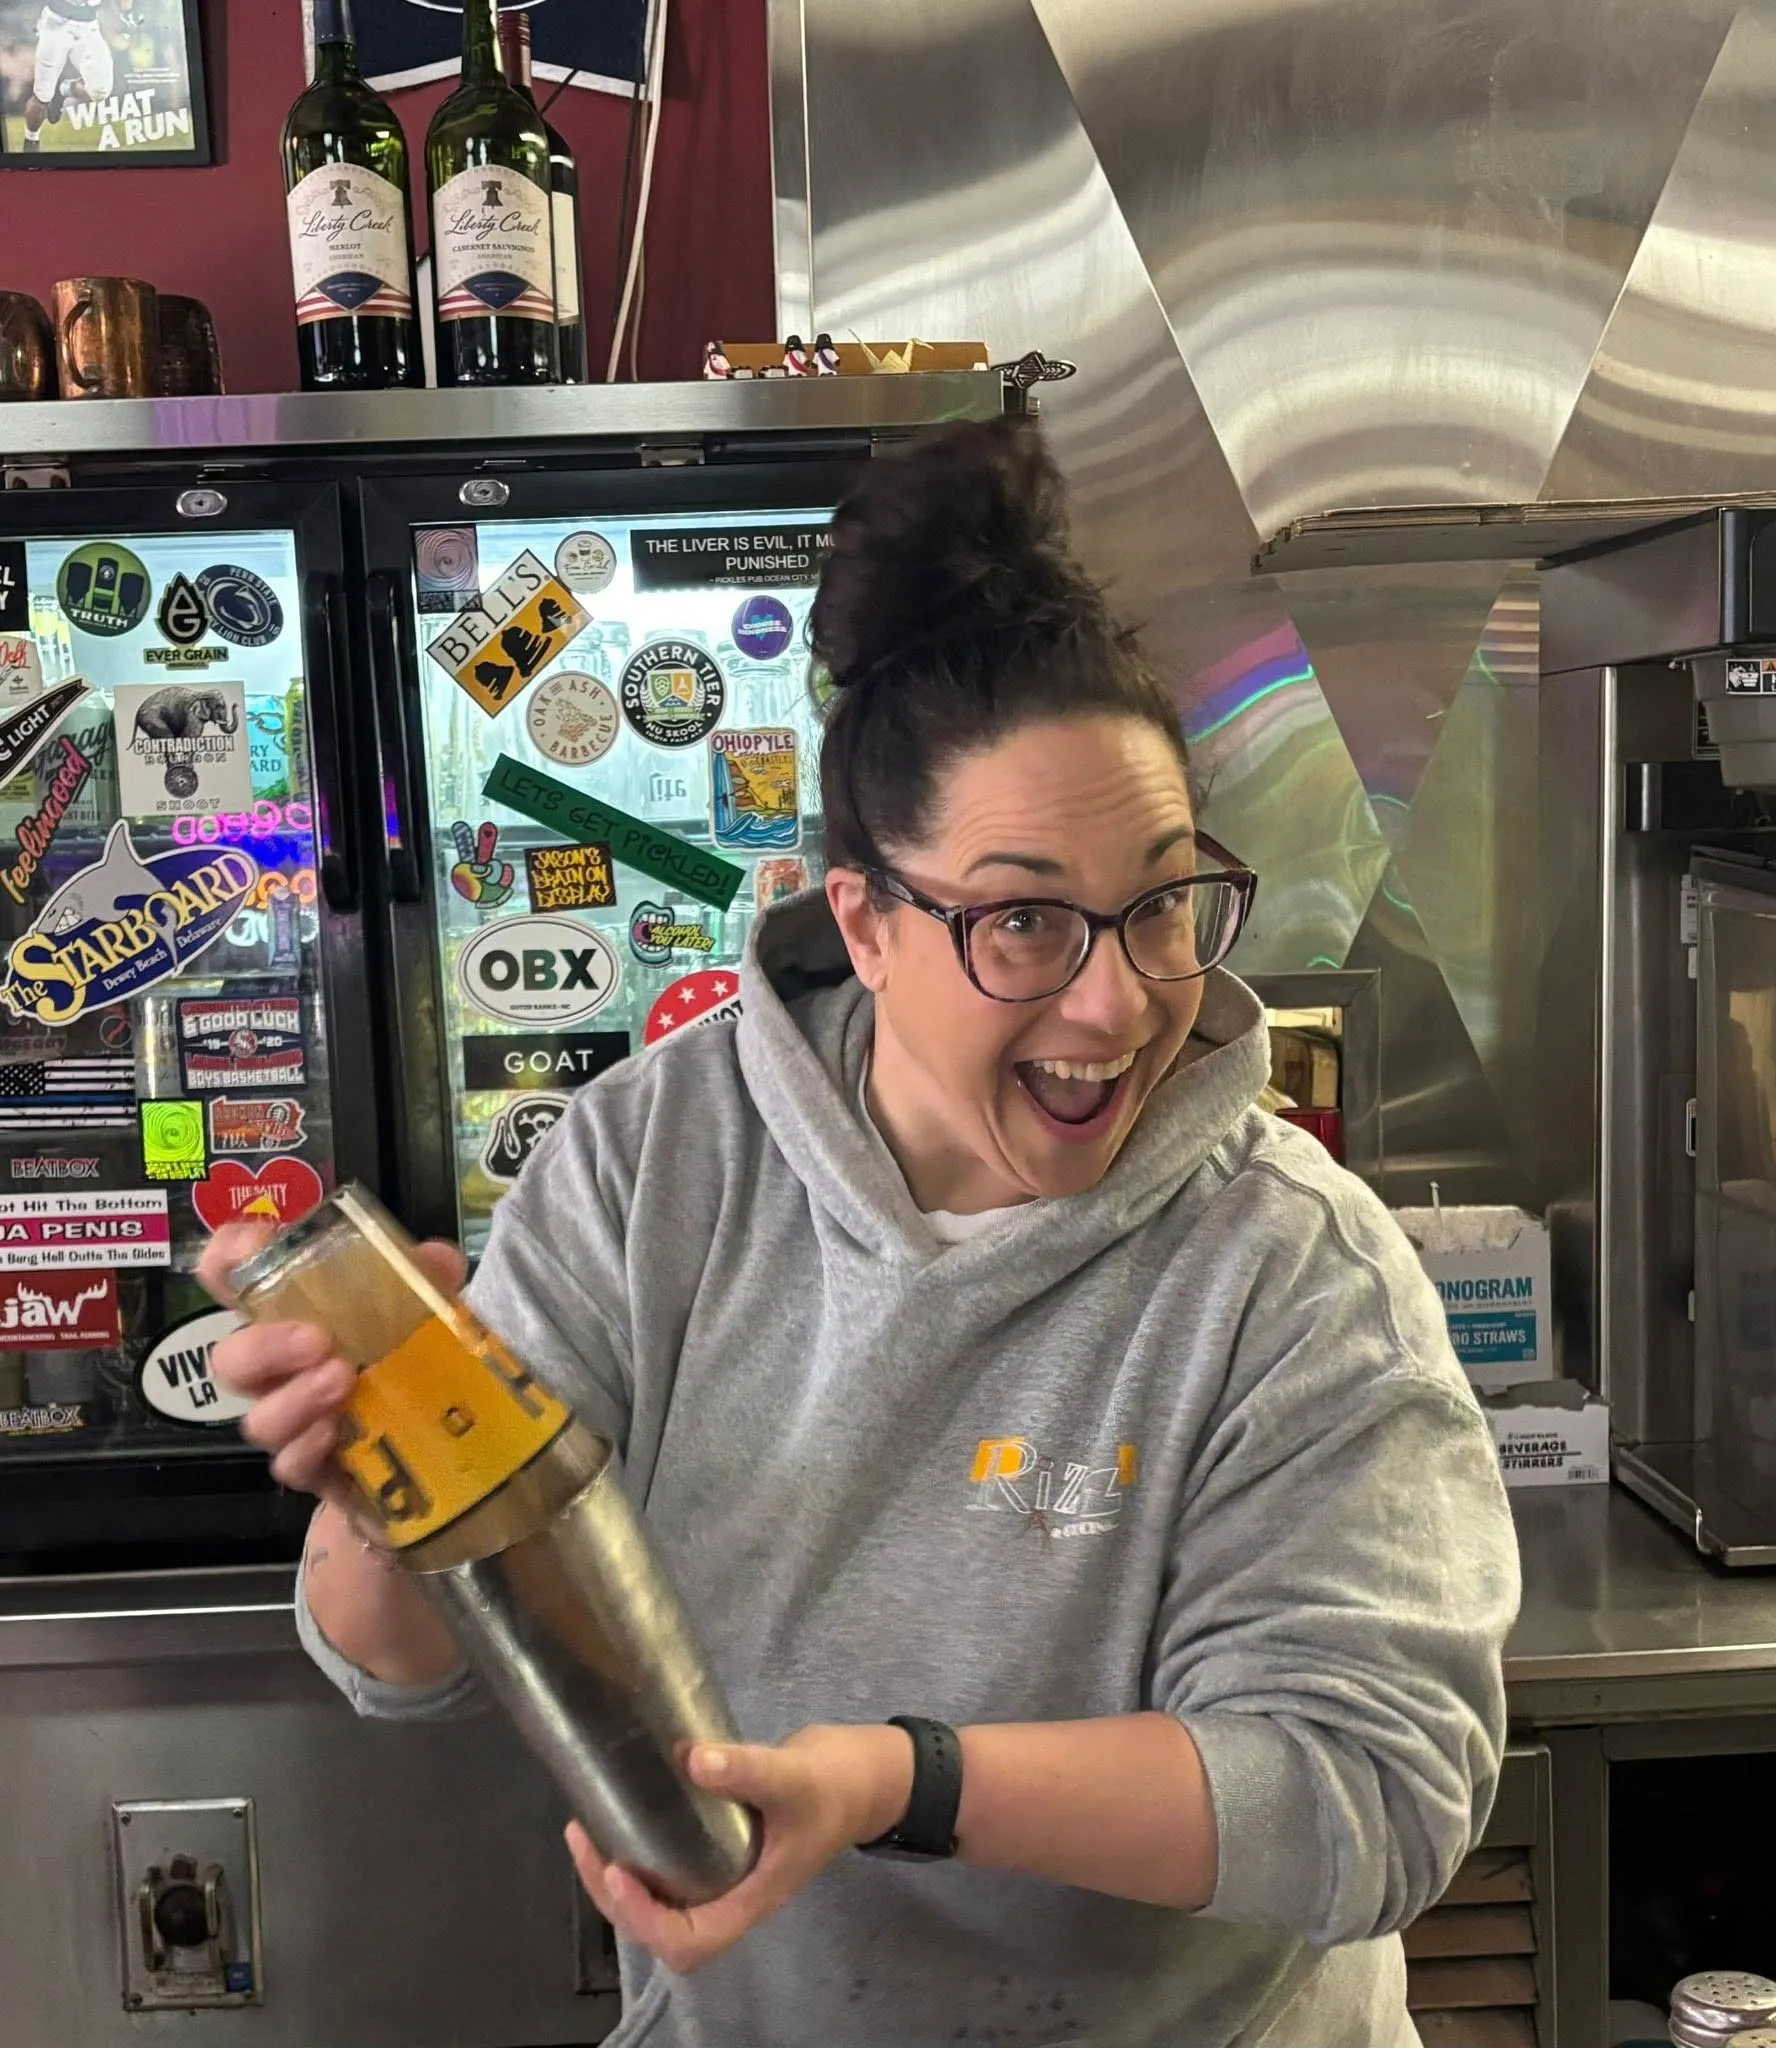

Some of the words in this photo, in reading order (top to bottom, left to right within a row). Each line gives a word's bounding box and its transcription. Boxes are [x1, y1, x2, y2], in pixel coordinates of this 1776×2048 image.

[66, 88, 155, 131] WHAT
[98, 124, 120, 151] A
[125, 108, 189, 145] RUN
[299, 210, 352, 241] Liberty
[349, 209, 394, 233] Creek
[444, 209, 499, 240] Liberty
[499, 211, 541, 236] Creek
[328, 243, 362, 251] MERLOT
[452, 243, 491, 252] CABERNET
[492, 243, 535, 253] SAUVIGNON
[646, 539, 679, 553] THE
[682, 537, 730, 551] LIVER
[734, 536, 749, 550] IS
[754, 534, 792, 550] EVIL,
[798, 534, 811, 547] IT
[726, 555, 809, 570] PUNISHED
[230, 567, 254, 582] PENN
[255, 578, 279, 604] STATE
[69, 608, 129, 628] TRUTH
[438, 564, 541, 667] BELL'S
[218, 626, 239, 643] LION
[240, 636, 266, 646] CLUB
[145, 651, 182, 662] EVER
[184, 649, 227, 661] GRAIN
[624, 645, 698, 708] SOUTHERN
[700, 662, 721, 706] TIER
[533, 694, 552, 727] OAK
[569, 679, 601, 700] ASH
[7, 704, 50, 747] LIGHT
[549, 714, 613, 760] BARBECUE
[645, 722, 662, 735] NU
[666, 721, 703, 737] SKOOL
[134, 735, 234, 755] CONTRADICTION
[712, 734, 795, 752] OHIOPYLE
[502, 769, 565, 811] LETS
[569, 806, 619, 838] GET
[531, 847, 601, 869] JASON'S
[530, 868, 584, 889] BRAIN
[585, 865, 607, 884] ON
[536, 884, 611, 908] DISPLAY
[12, 853, 254, 1022] STARBOARD
[651, 924, 703, 938] ALCOHOL
[650, 935, 675, 946] YOU
[675, 935, 714, 951] LATER!
[102, 969, 136, 992] Dewey
[136, 947, 168, 972] Beach
[176, 918, 222, 948] Delaware
[479, 949, 600, 992] OBX
[4, 979, 48, 1012] The
[200, 1011, 248, 1034] GOOD
[504, 1050, 594, 1074] GOAT
[187, 1070, 221, 1089] BOYS
[223, 1067, 306, 1088] BASKETBALL
[11, 1156, 100, 1179] BEATBOX
[23, 1201, 47, 1212] Hit
[95, 1197, 162, 1210] Bottom
[42, 1221, 144, 1240] PENIS
[60, 1331, 79, 1340] TRAIL
[80, 1330, 110, 1340] RUNNING
[1473, 1330, 1526, 1345] STRAWS
[188, 1380, 218, 1409] LA
[1499, 1441, 1567, 1454] BEVERAGE
[1503, 1457, 1563, 1470] STIRRERS
